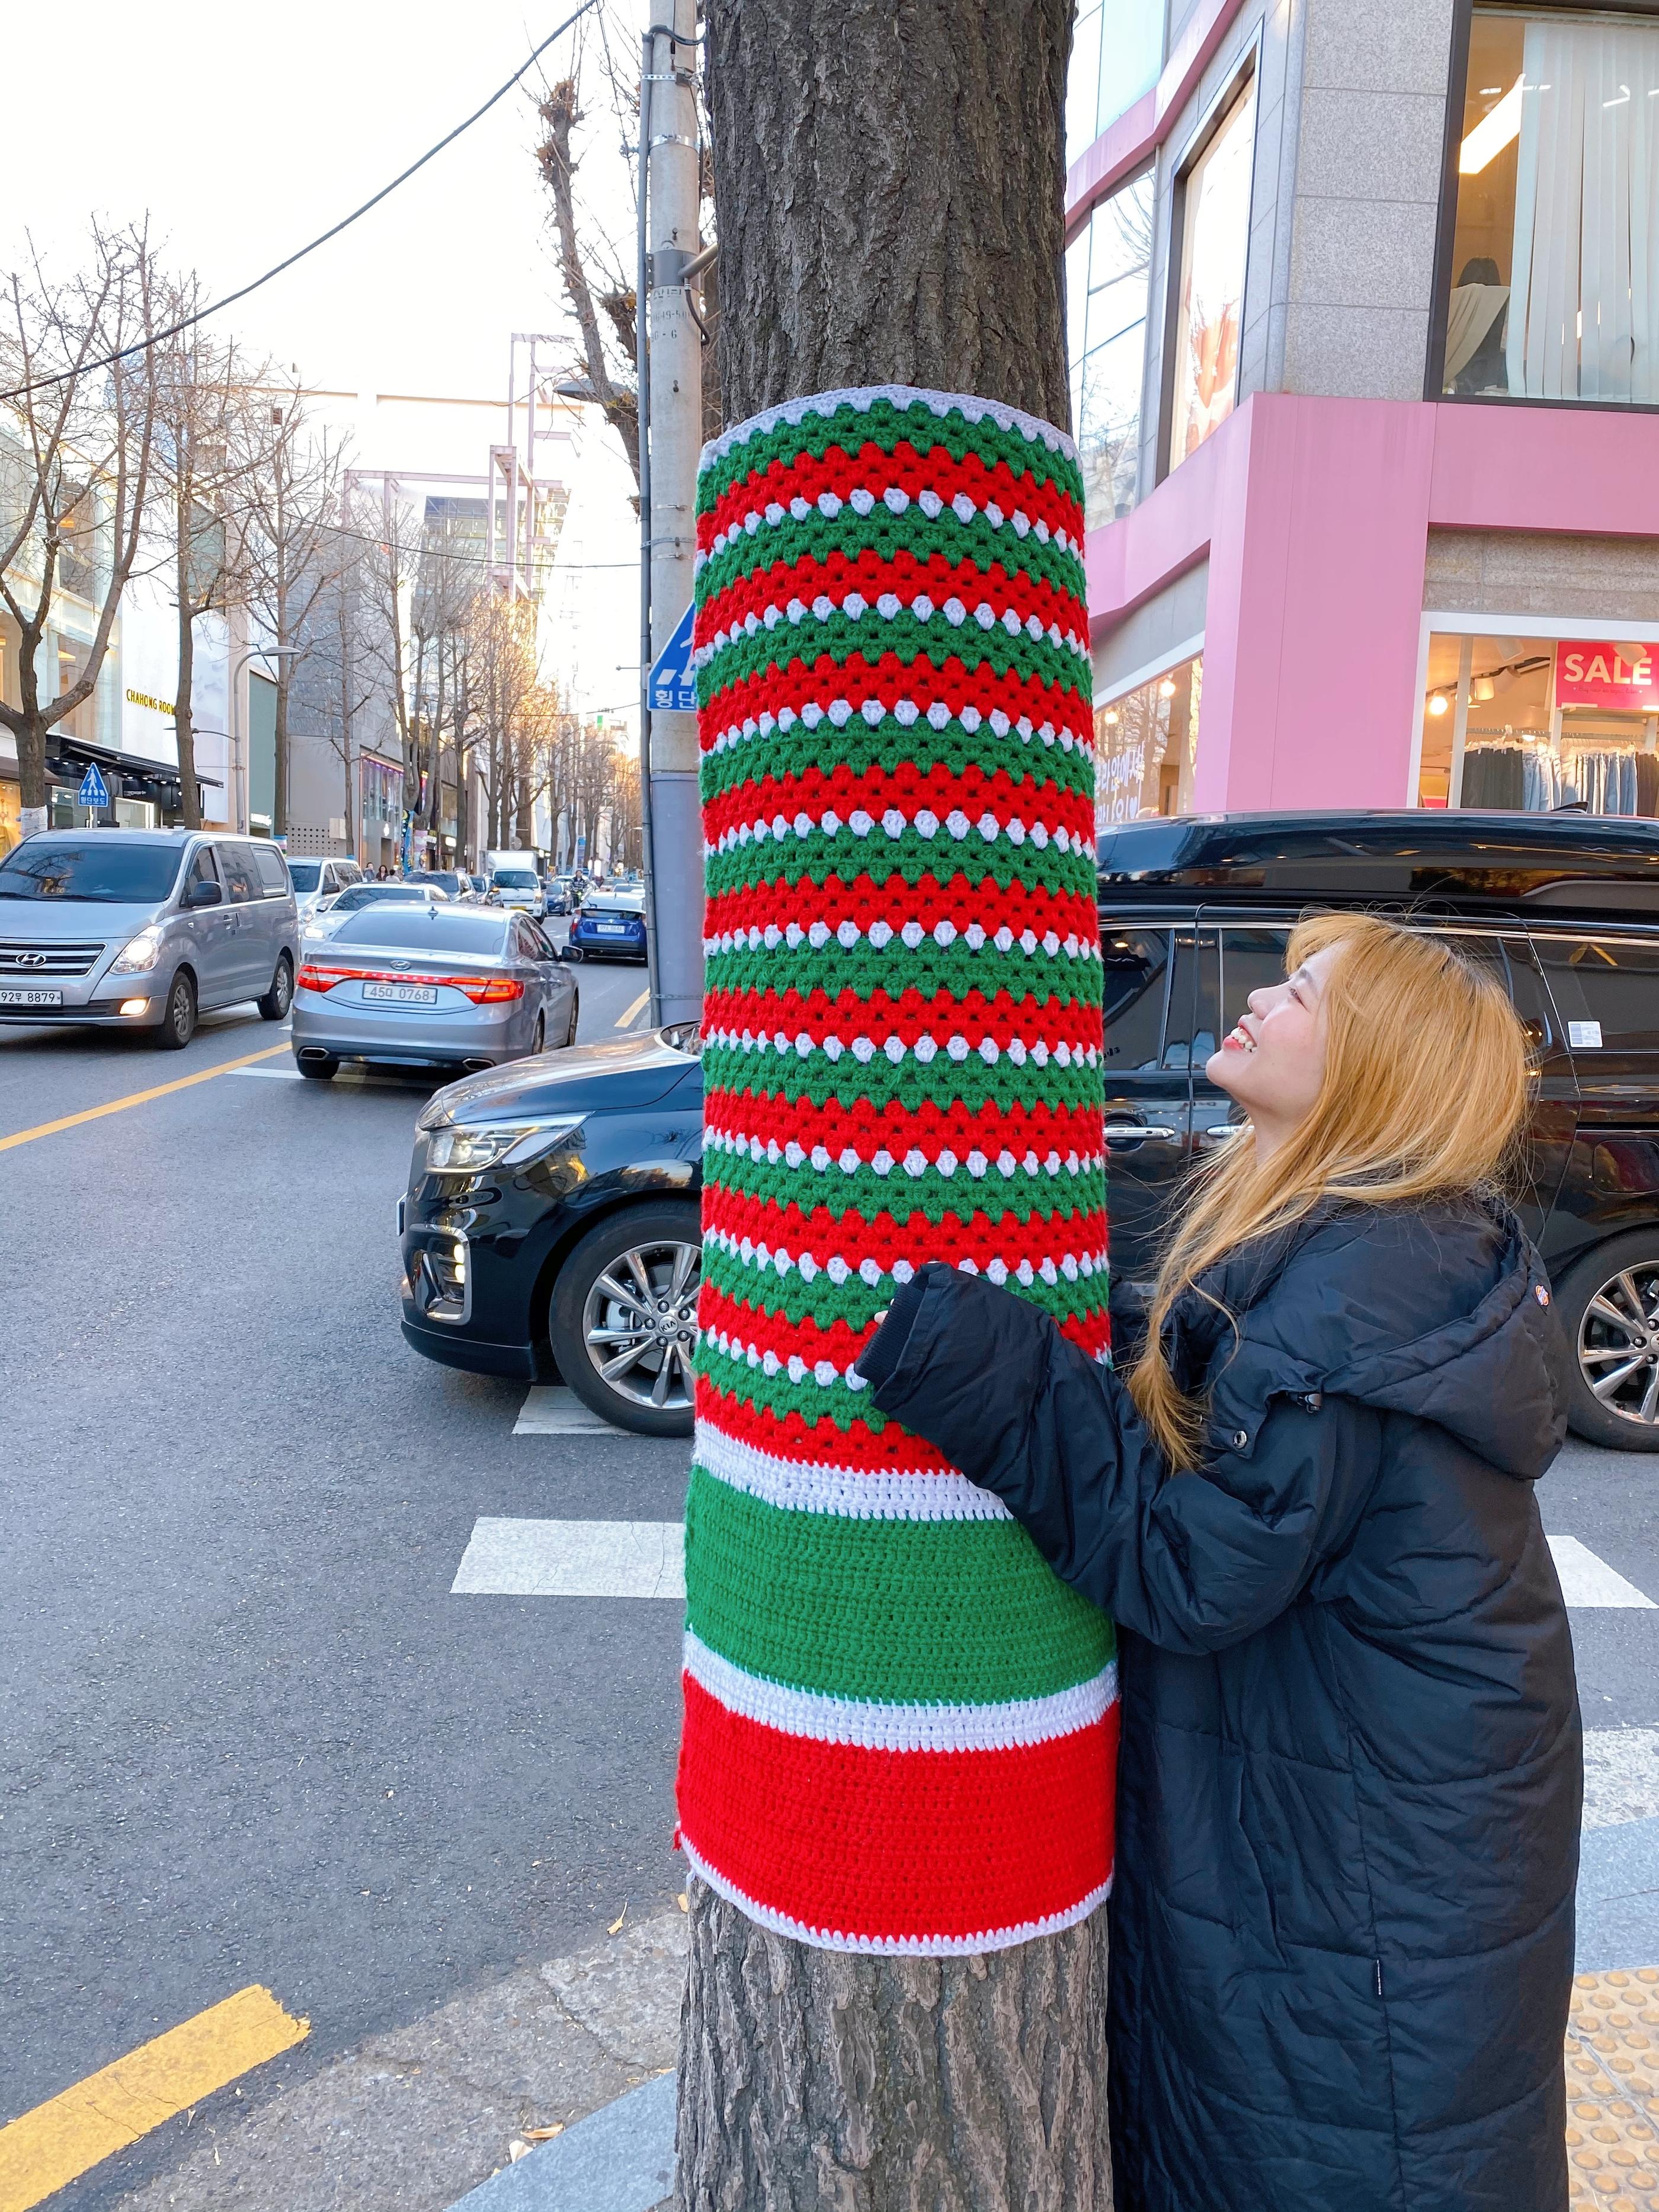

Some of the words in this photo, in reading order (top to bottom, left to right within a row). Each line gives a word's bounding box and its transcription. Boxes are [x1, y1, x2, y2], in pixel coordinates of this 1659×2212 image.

[1564, 653, 1652, 685] SALE
[126, 689, 157, 709] CHAHONG
[80, 796, 105, 805] 횡단보도
[1, 992, 22, 1002] 92무
[28, 993, 55, 1003] 8879
[399, 988, 429, 1001] 0768
[661, 1321, 676, 1331] KIA
